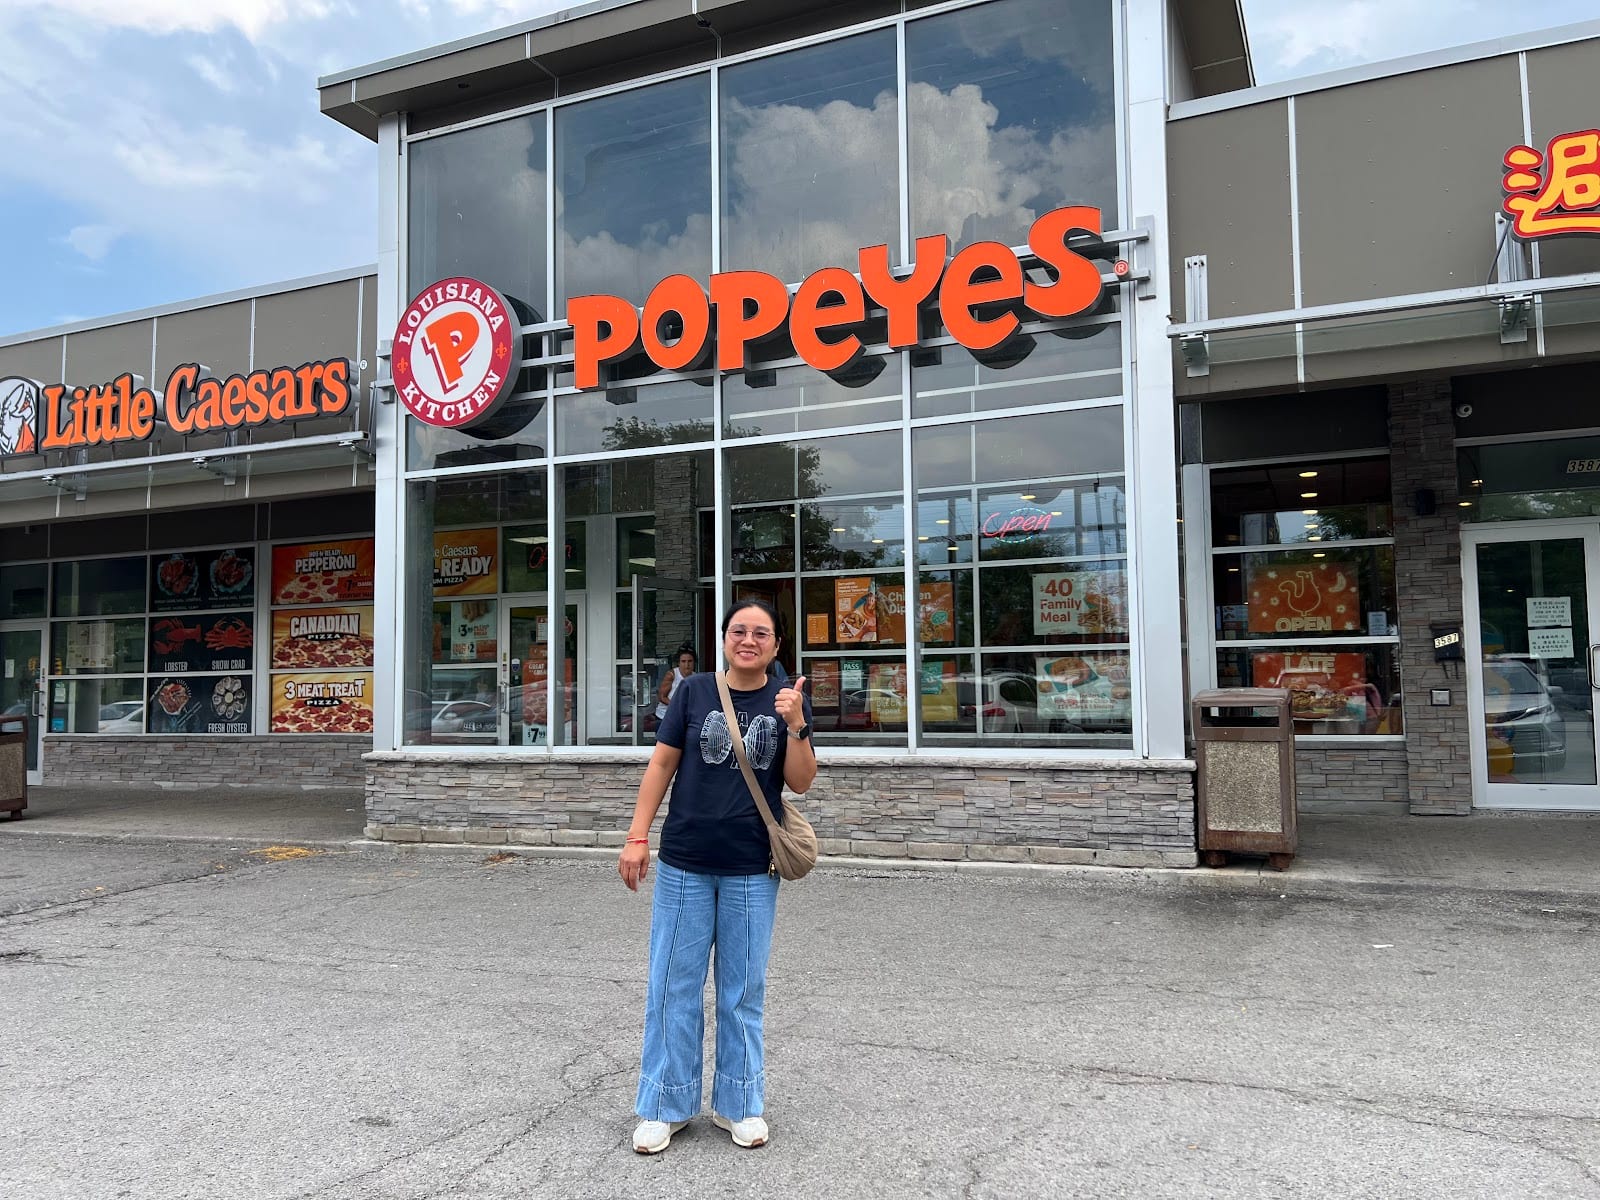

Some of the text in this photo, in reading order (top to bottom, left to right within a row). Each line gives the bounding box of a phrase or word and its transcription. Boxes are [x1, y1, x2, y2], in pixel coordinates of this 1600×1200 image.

[399, 283, 504, 345] LOUISIANA
[402, 369, 501, 421] KITCHEN
[41, 360, 349, 448] Little Caesars
[982, 511, 1052, 539] Open
[441, 545, 478, 557] Caesars
[295, 554, 356, 573] PEPPERONI
[1040, 598, 1082, 610] Family
[1040, 611, 1071, 623] Meal
[1275, 616, 1332, 632] OPEN
[290, 614, 359, 638] CANADIAN
[164, 661, 188, 671] LOBSTER
[211, 659, 246, 670] SNOW CRAB
[1284, 656, 1336, 673] LATE
[284, 679, 366, 700] 3 MEAT TREAT
[208, 723, 248, 733] FRESH OYSTER
